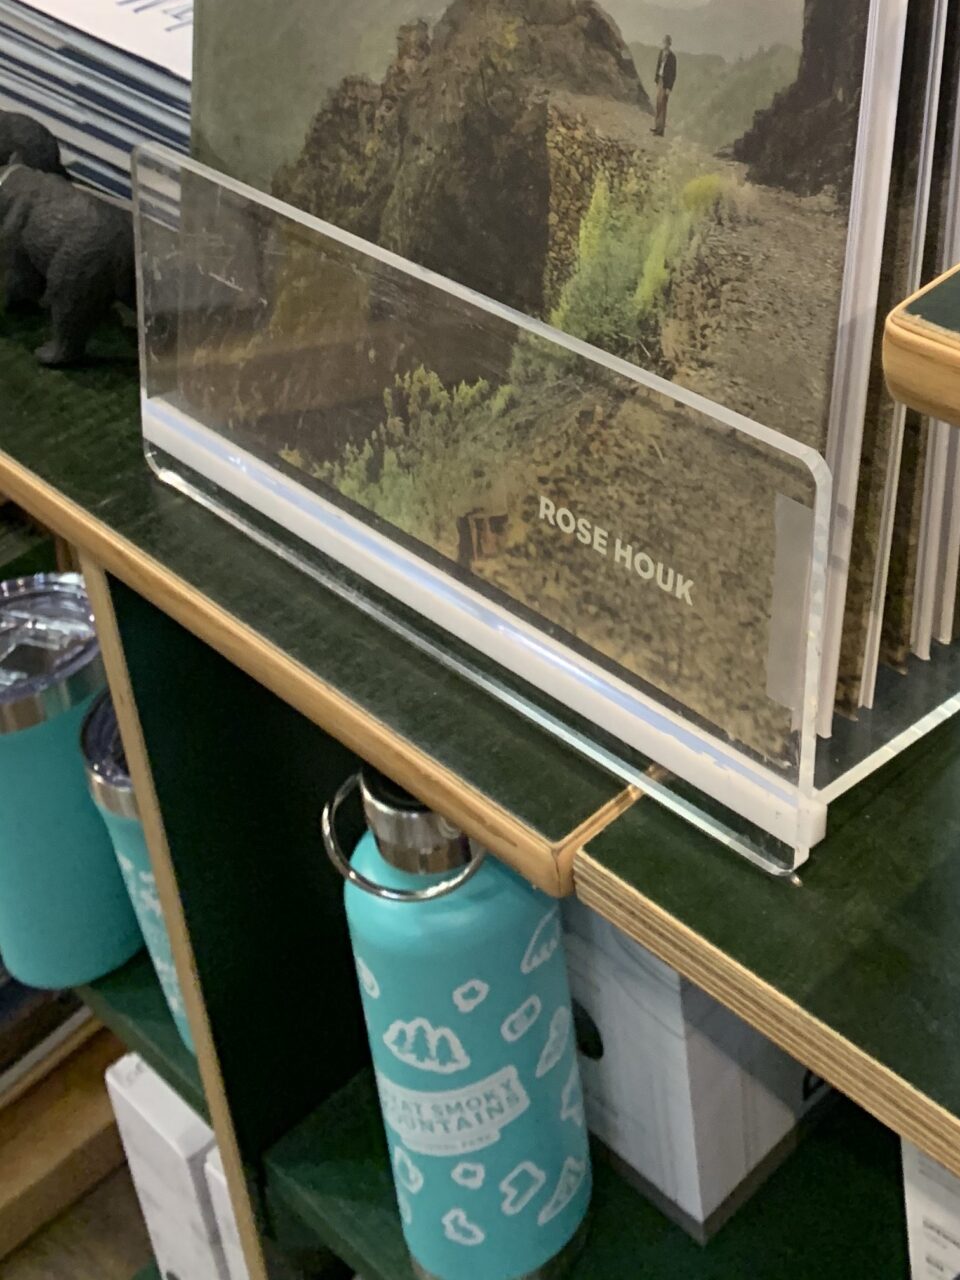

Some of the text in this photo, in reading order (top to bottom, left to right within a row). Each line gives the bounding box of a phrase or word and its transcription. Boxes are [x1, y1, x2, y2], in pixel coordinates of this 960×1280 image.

[538, 495, 695, 607] ROSE HOUK
[430, 1077, 512, 1119] SMOKY
